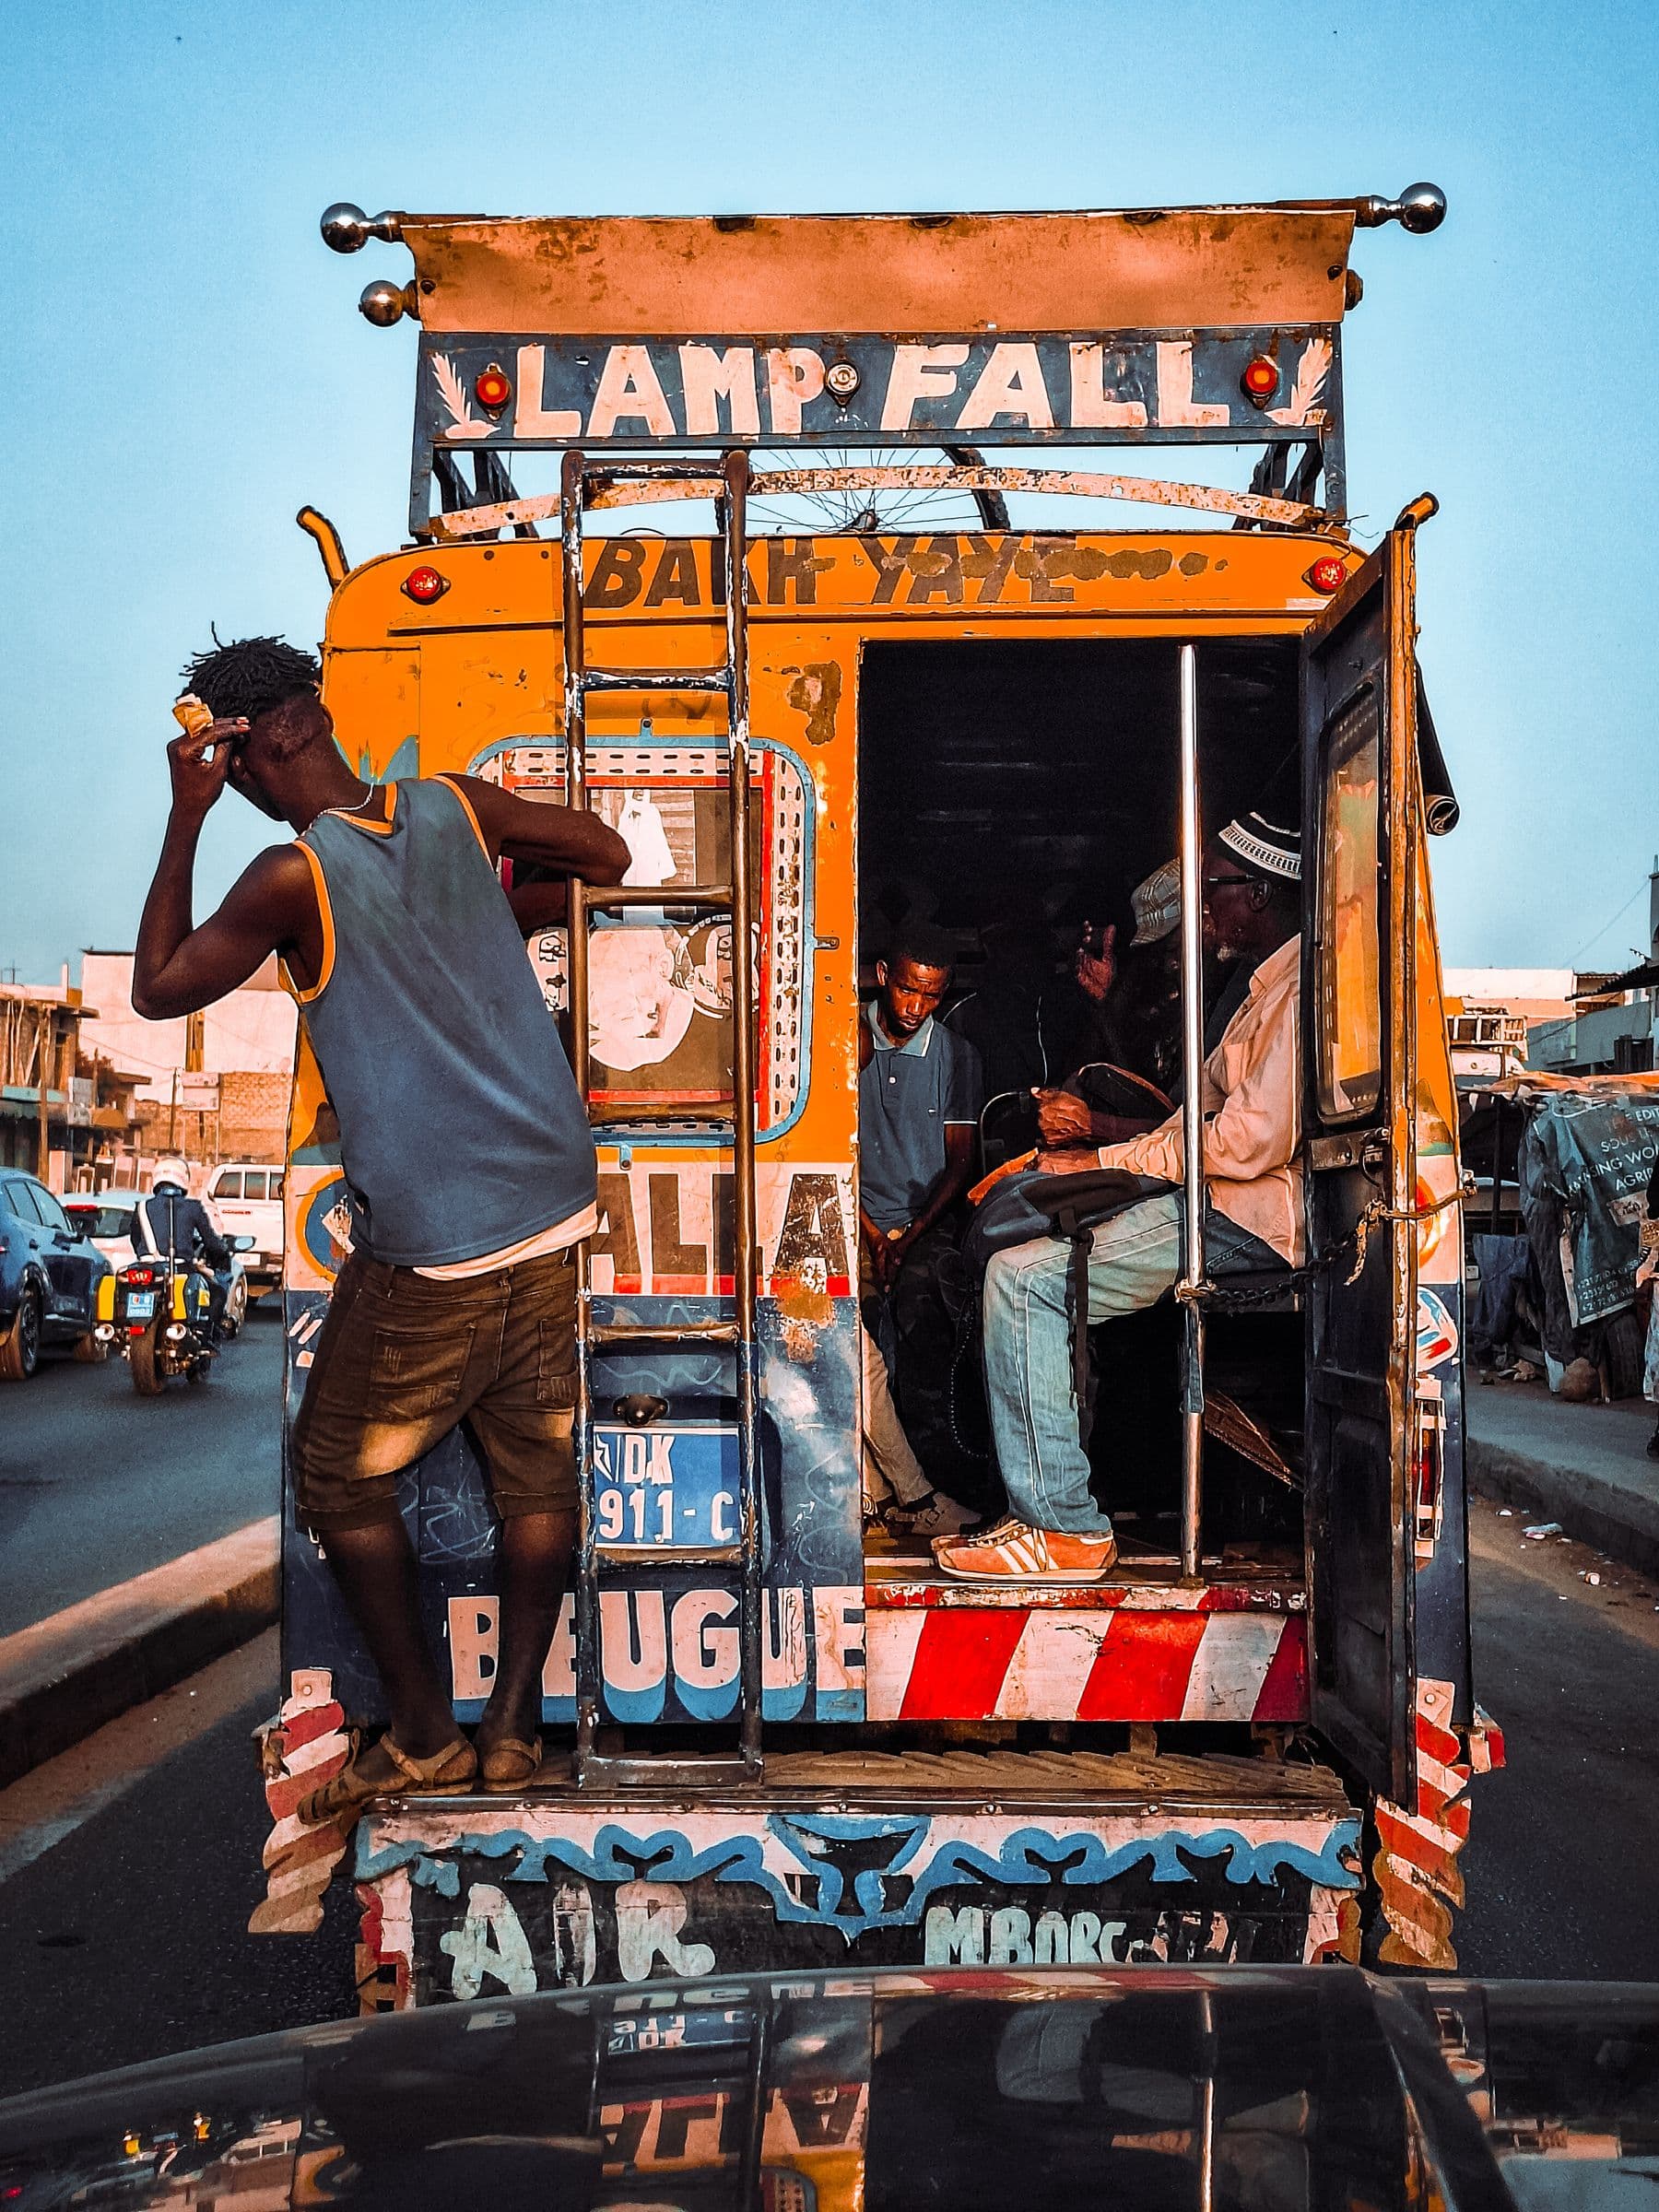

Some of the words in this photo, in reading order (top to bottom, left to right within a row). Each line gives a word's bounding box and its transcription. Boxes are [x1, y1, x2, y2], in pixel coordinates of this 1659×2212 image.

[513, 344, 826, 438] LAMP
[880, 341, 1230, 430] FALL
[858, 536, 1077, 603] YAYE
[624, 1434, 675, 1485] DK
